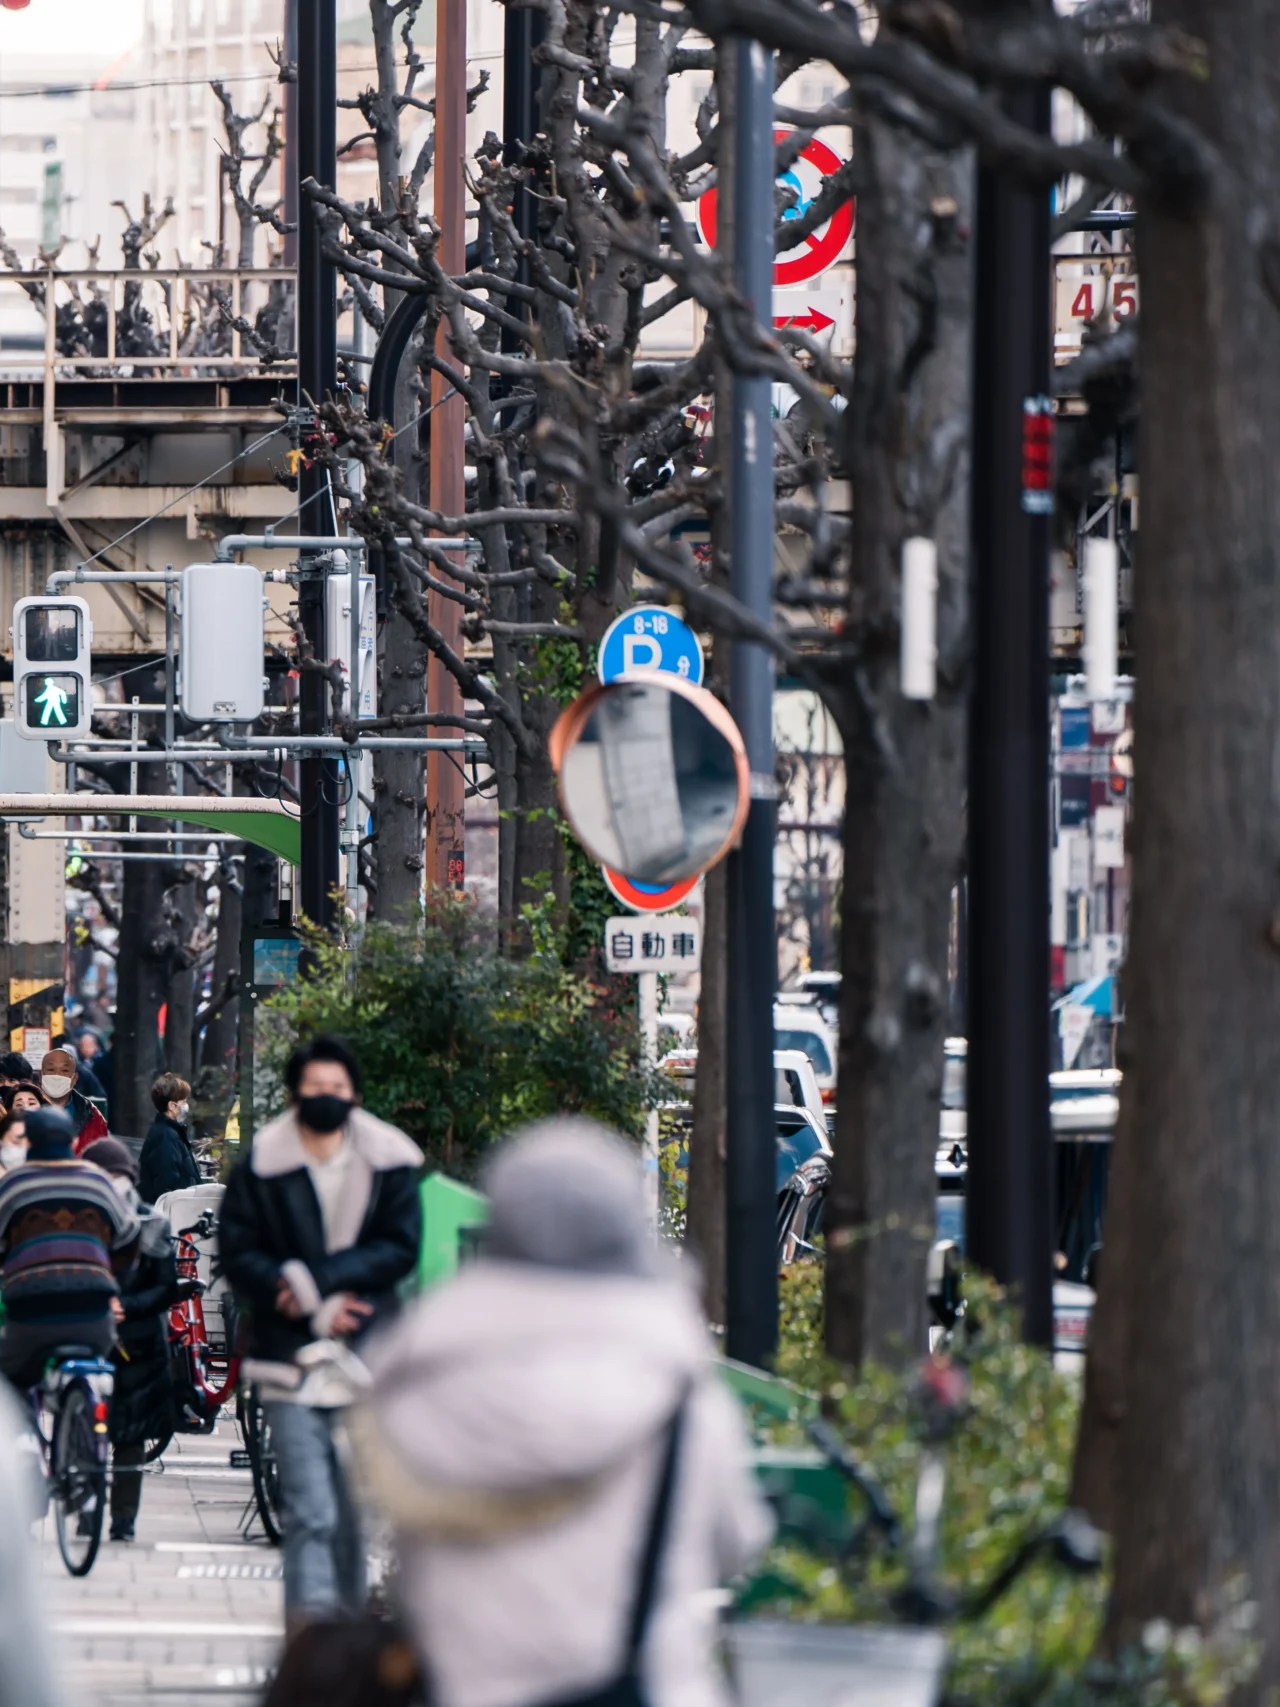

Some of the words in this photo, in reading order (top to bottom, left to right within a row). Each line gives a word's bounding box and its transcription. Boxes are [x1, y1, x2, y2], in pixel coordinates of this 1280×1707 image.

[634, 614, 669, 635] 8-18
[623, 633, 662, 673] P
[612, 930, 695, 959] 自動車
